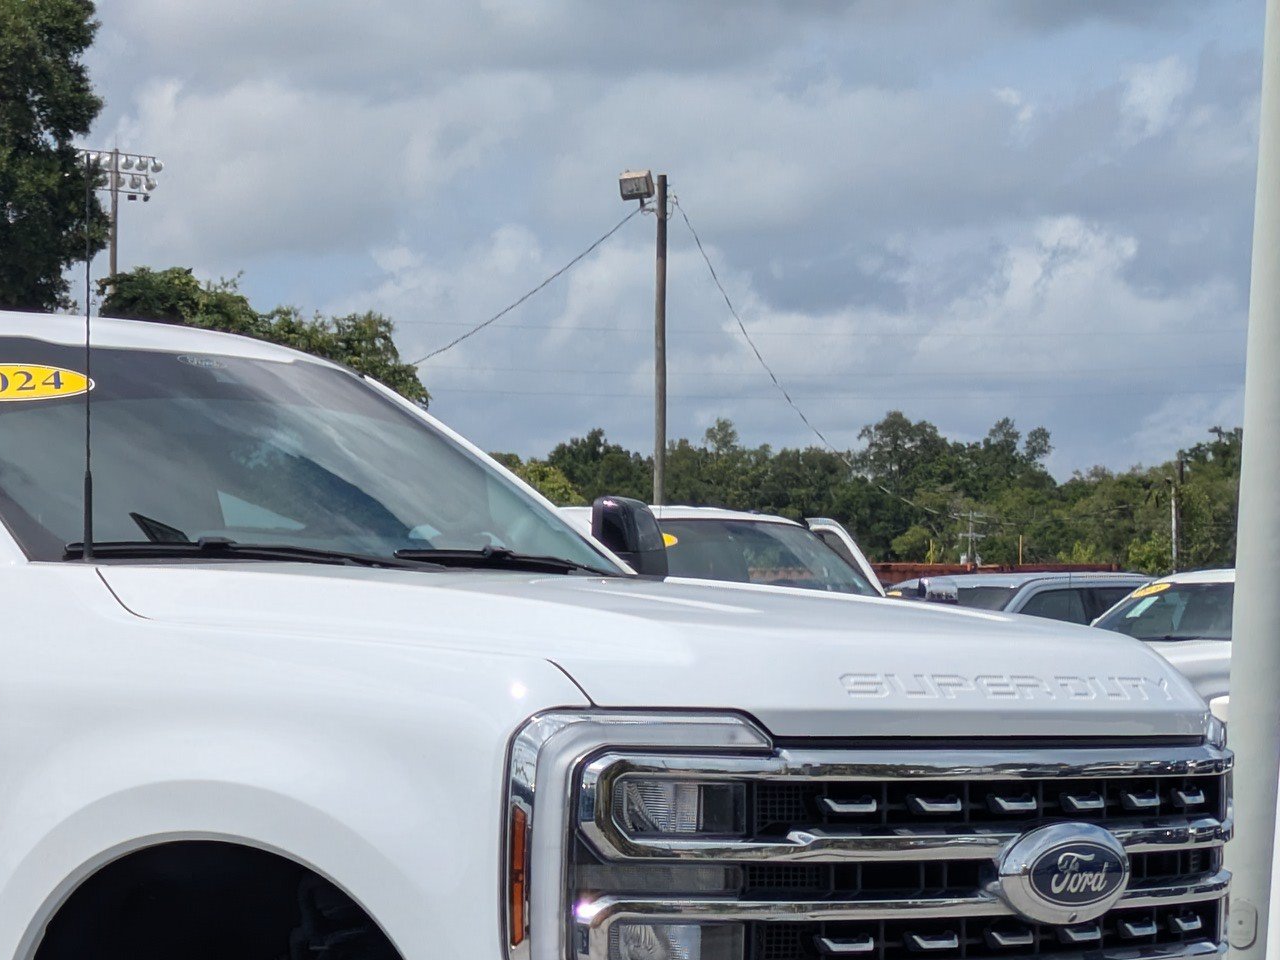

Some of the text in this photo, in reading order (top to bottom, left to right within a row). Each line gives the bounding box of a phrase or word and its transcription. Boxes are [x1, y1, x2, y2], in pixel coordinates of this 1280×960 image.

[838, 673, 1173, 700] SUPER DUTY
[1051, 852, 1109, 894] Ford
